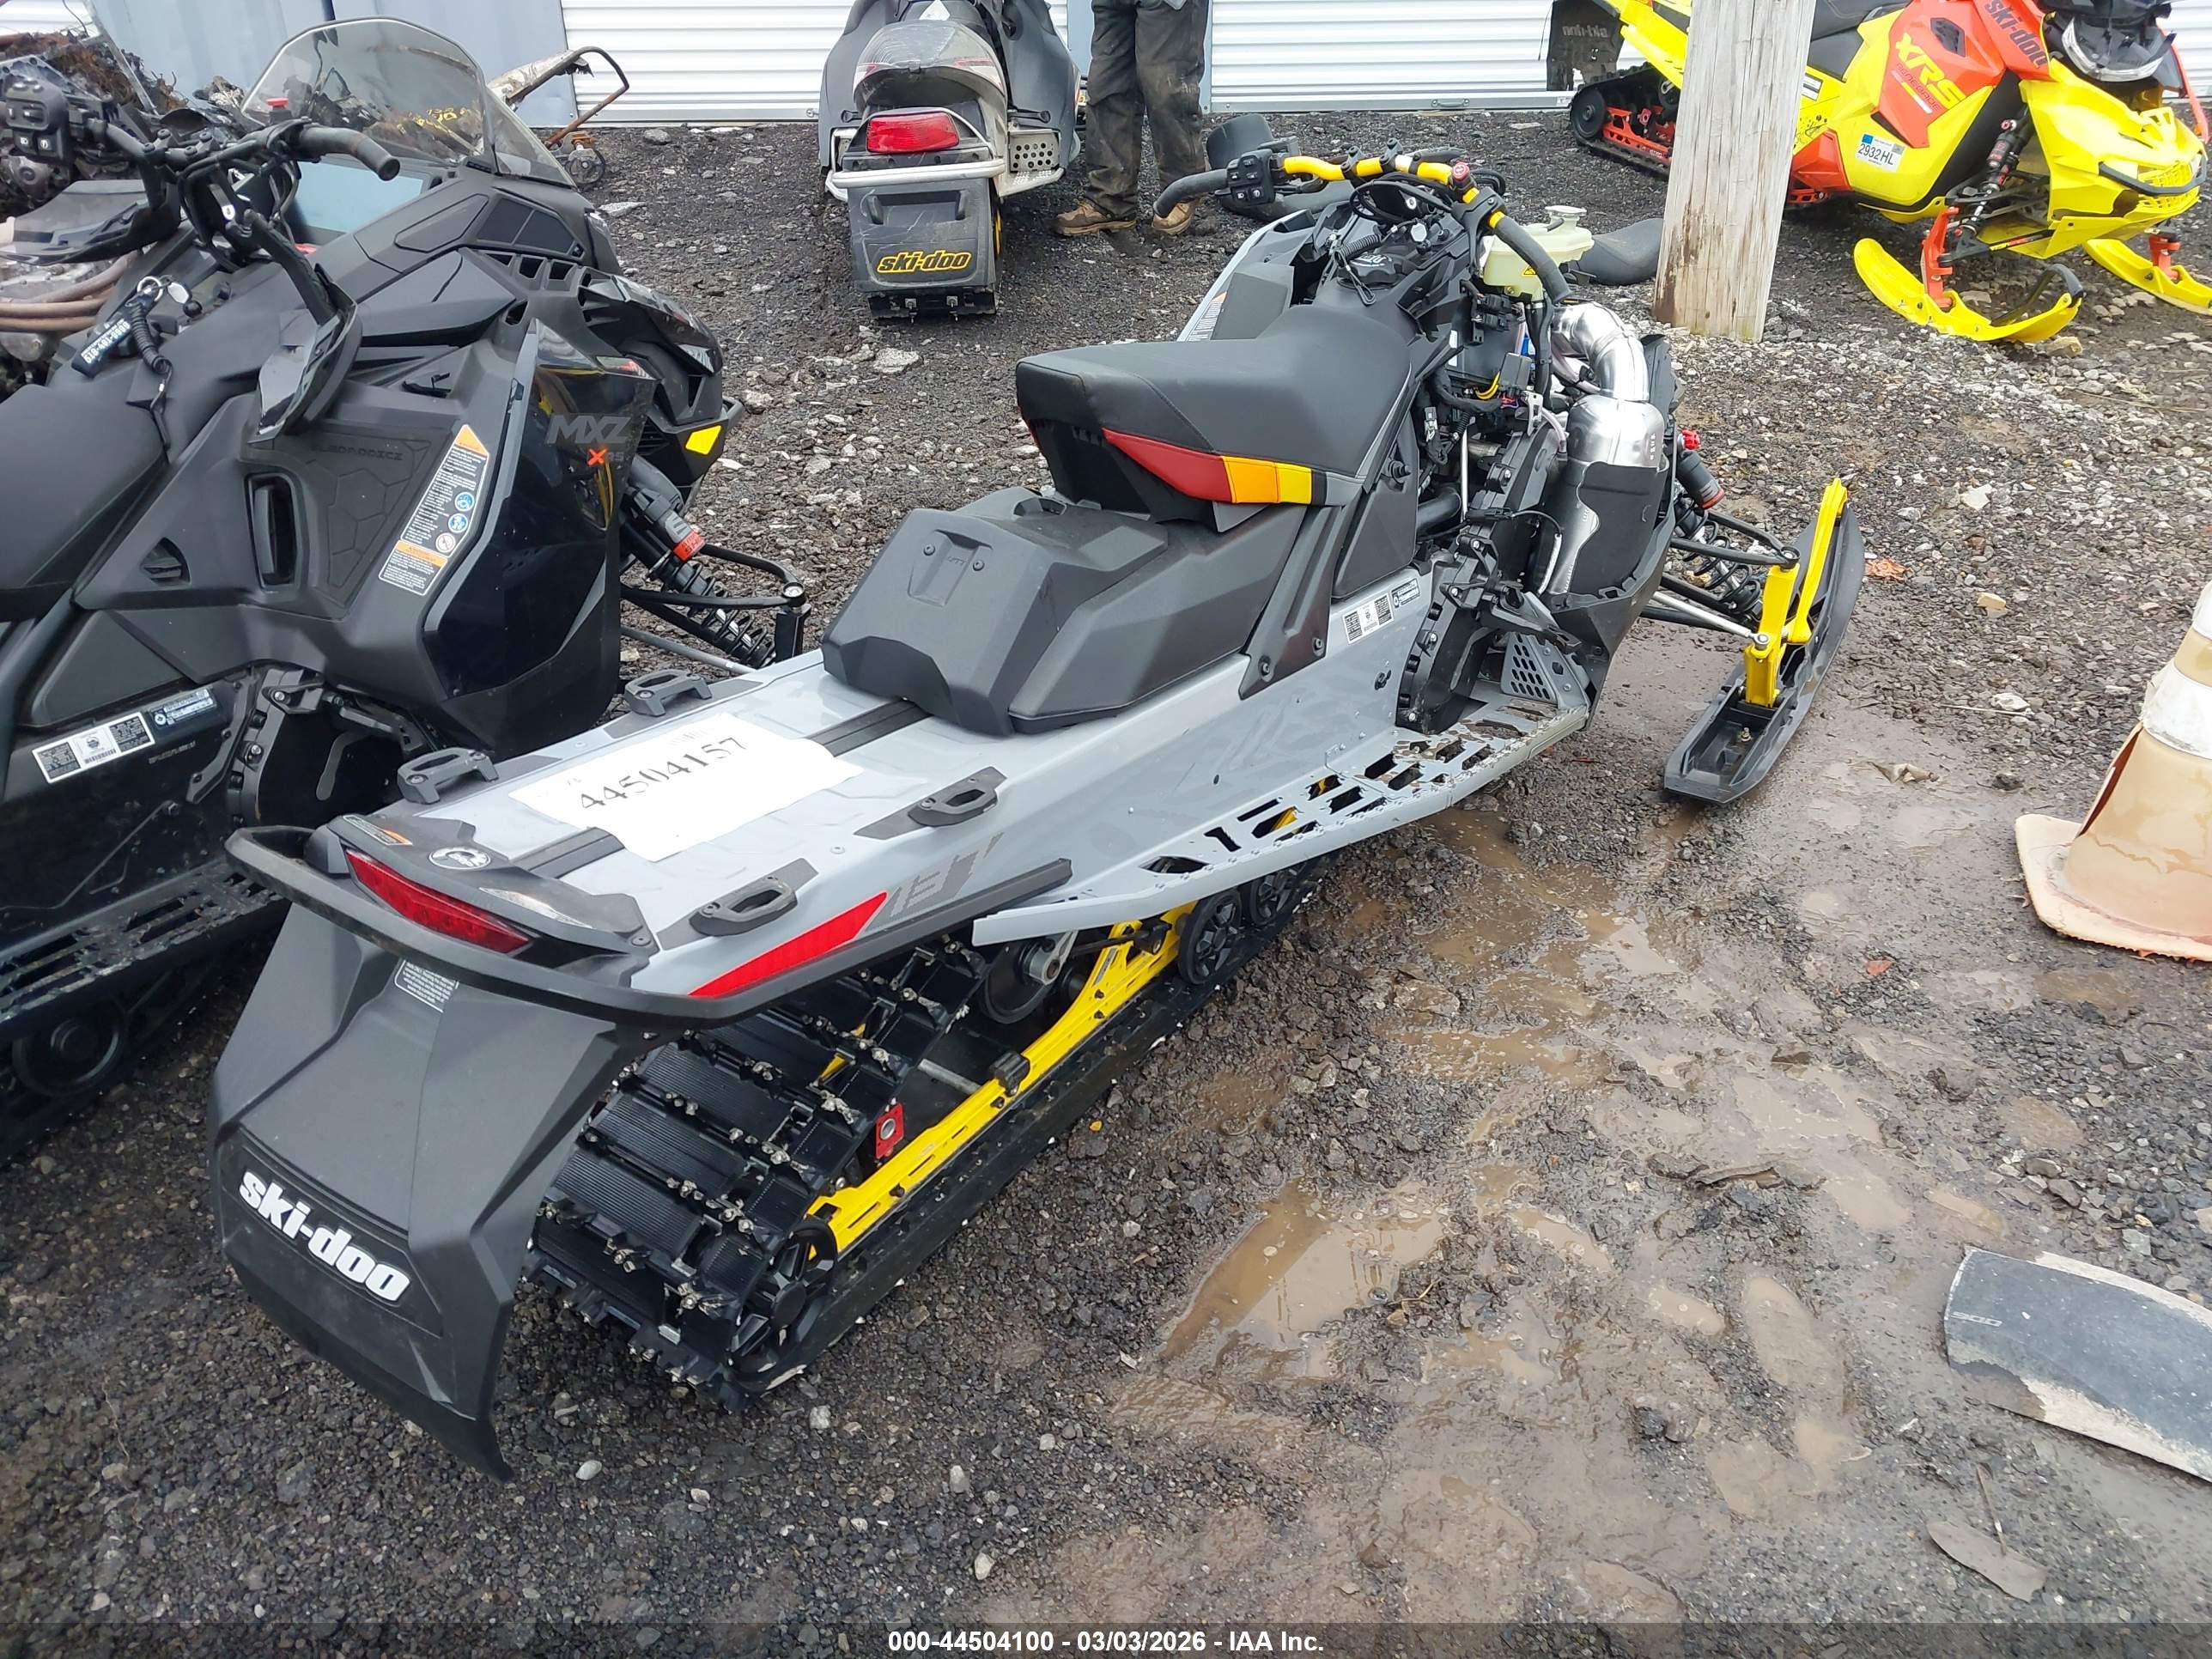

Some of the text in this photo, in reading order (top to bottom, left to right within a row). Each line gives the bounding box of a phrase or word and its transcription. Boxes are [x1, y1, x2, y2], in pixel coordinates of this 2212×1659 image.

[1895, 33, 1967, 109] XRS
[877, 250, 971, 273] ski-doo
[546, 415, 631, 444] MXZ
[580, 737, 747, 809] 44504157
[239, 1171, 411, 1302] ski-doo
